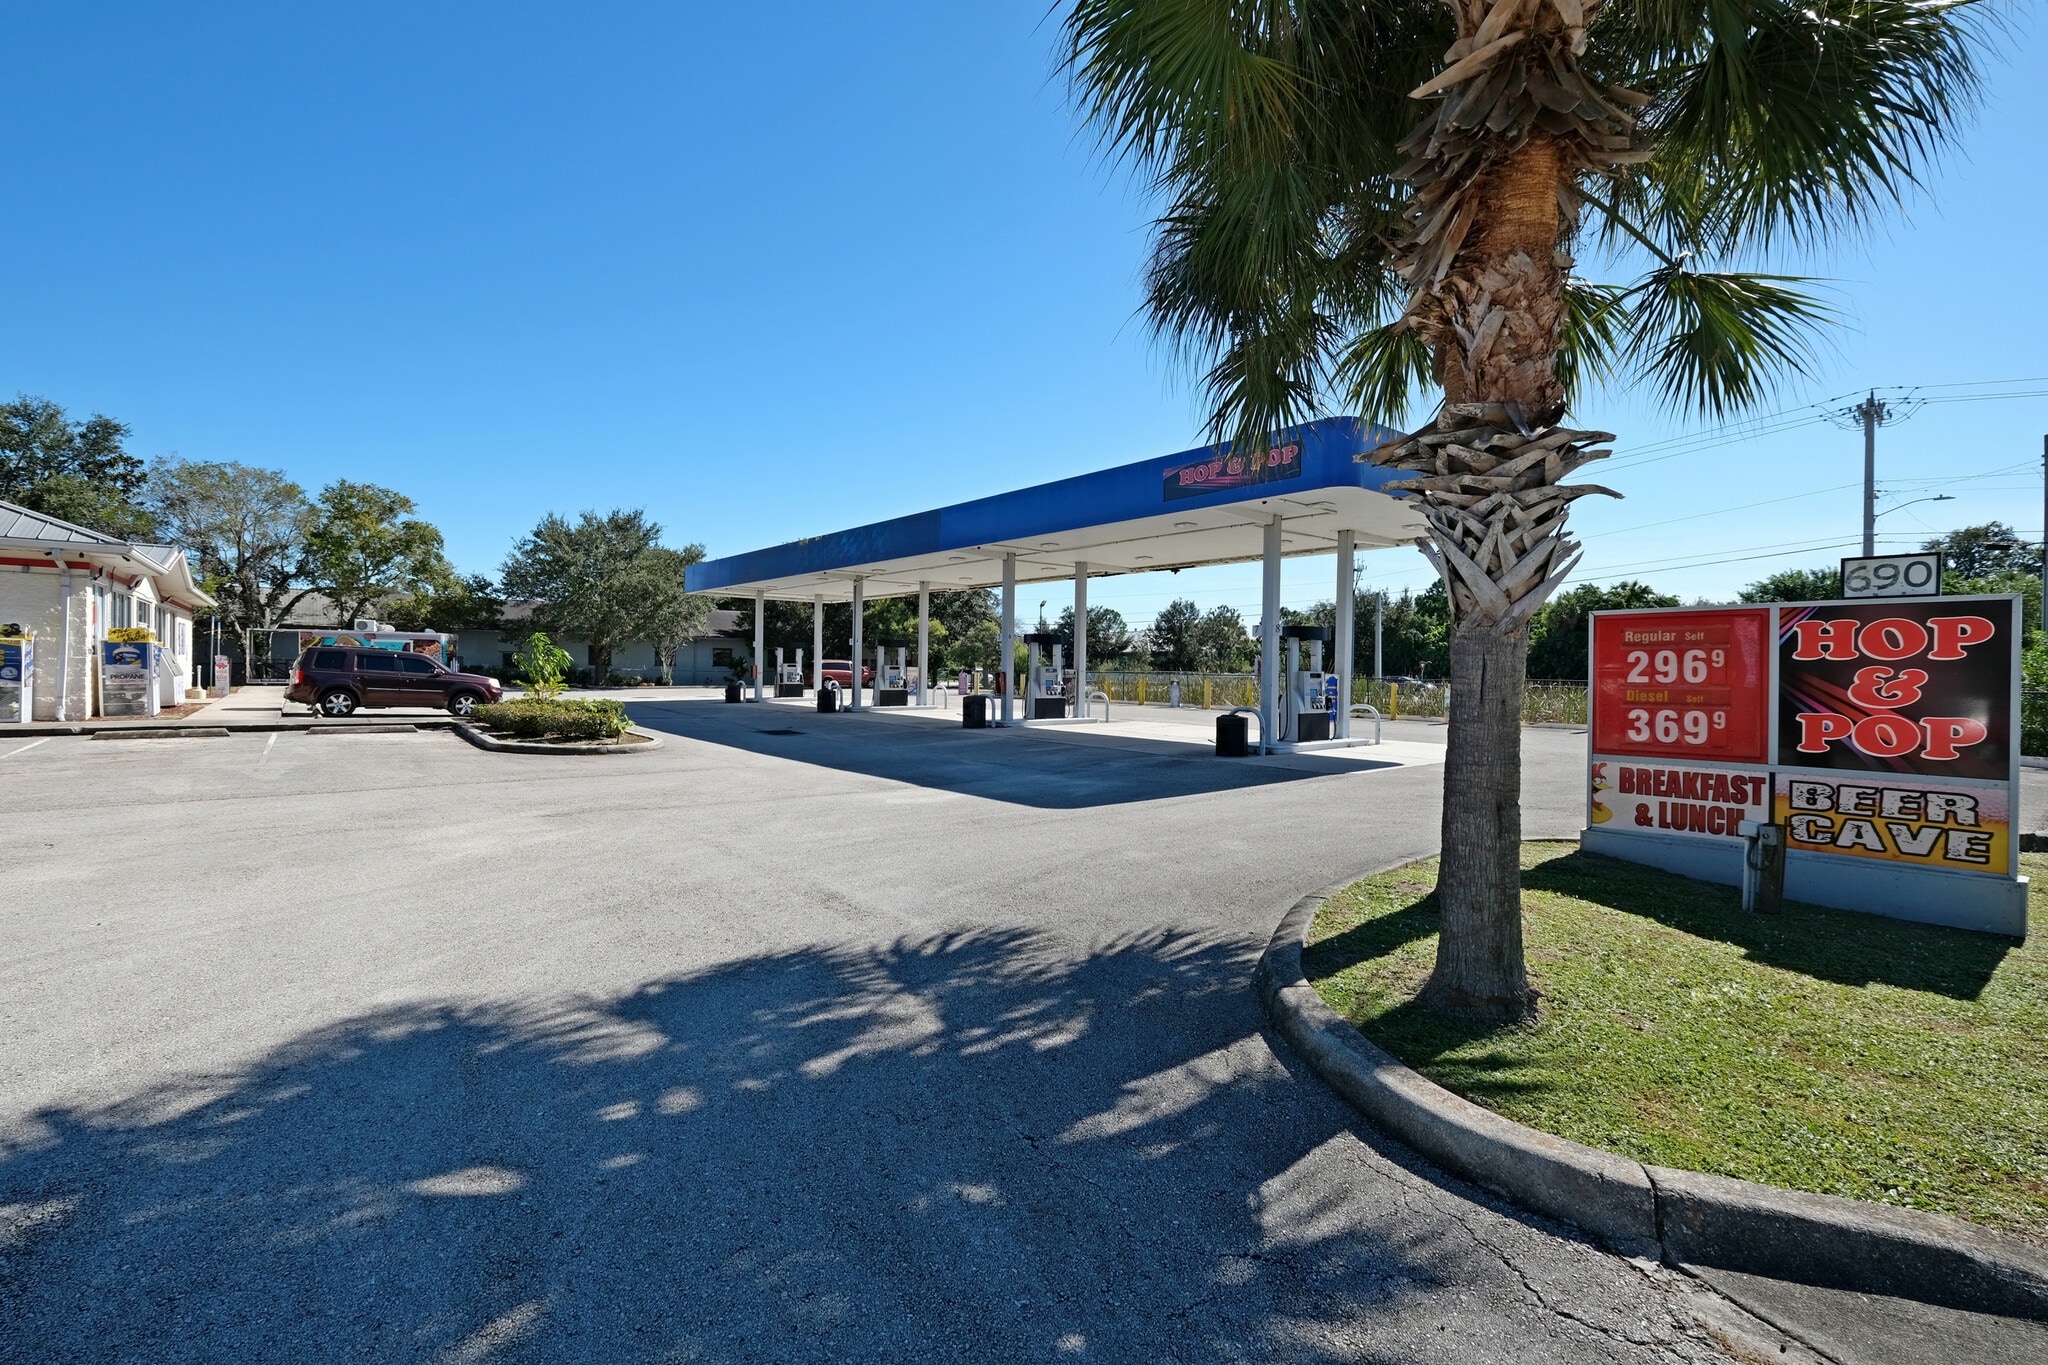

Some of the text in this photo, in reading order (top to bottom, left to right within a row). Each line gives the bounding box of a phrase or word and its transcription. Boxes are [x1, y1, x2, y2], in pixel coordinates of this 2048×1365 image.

[1179, 461, 1222, 485] HOP
[1227, 457, 1245, 474] &
[1845, 561, 1932, 592] 690
[1625, 631, 1704, 643] Regular Self
[1792, 616, 1995, 660] HOP
[1626, 690, 1704, 703] Diesel Self
[1848, 666, 1928, 709] &
[1796, 713, 1987, 760] POP
[1618, 767, 1767, 806] BREAKFAST
[1790, 781, 1981, 826] BEER
[1634, 801, 1745, 837] & LUNCH
[1788, 814, 1993, 864] CAVE
